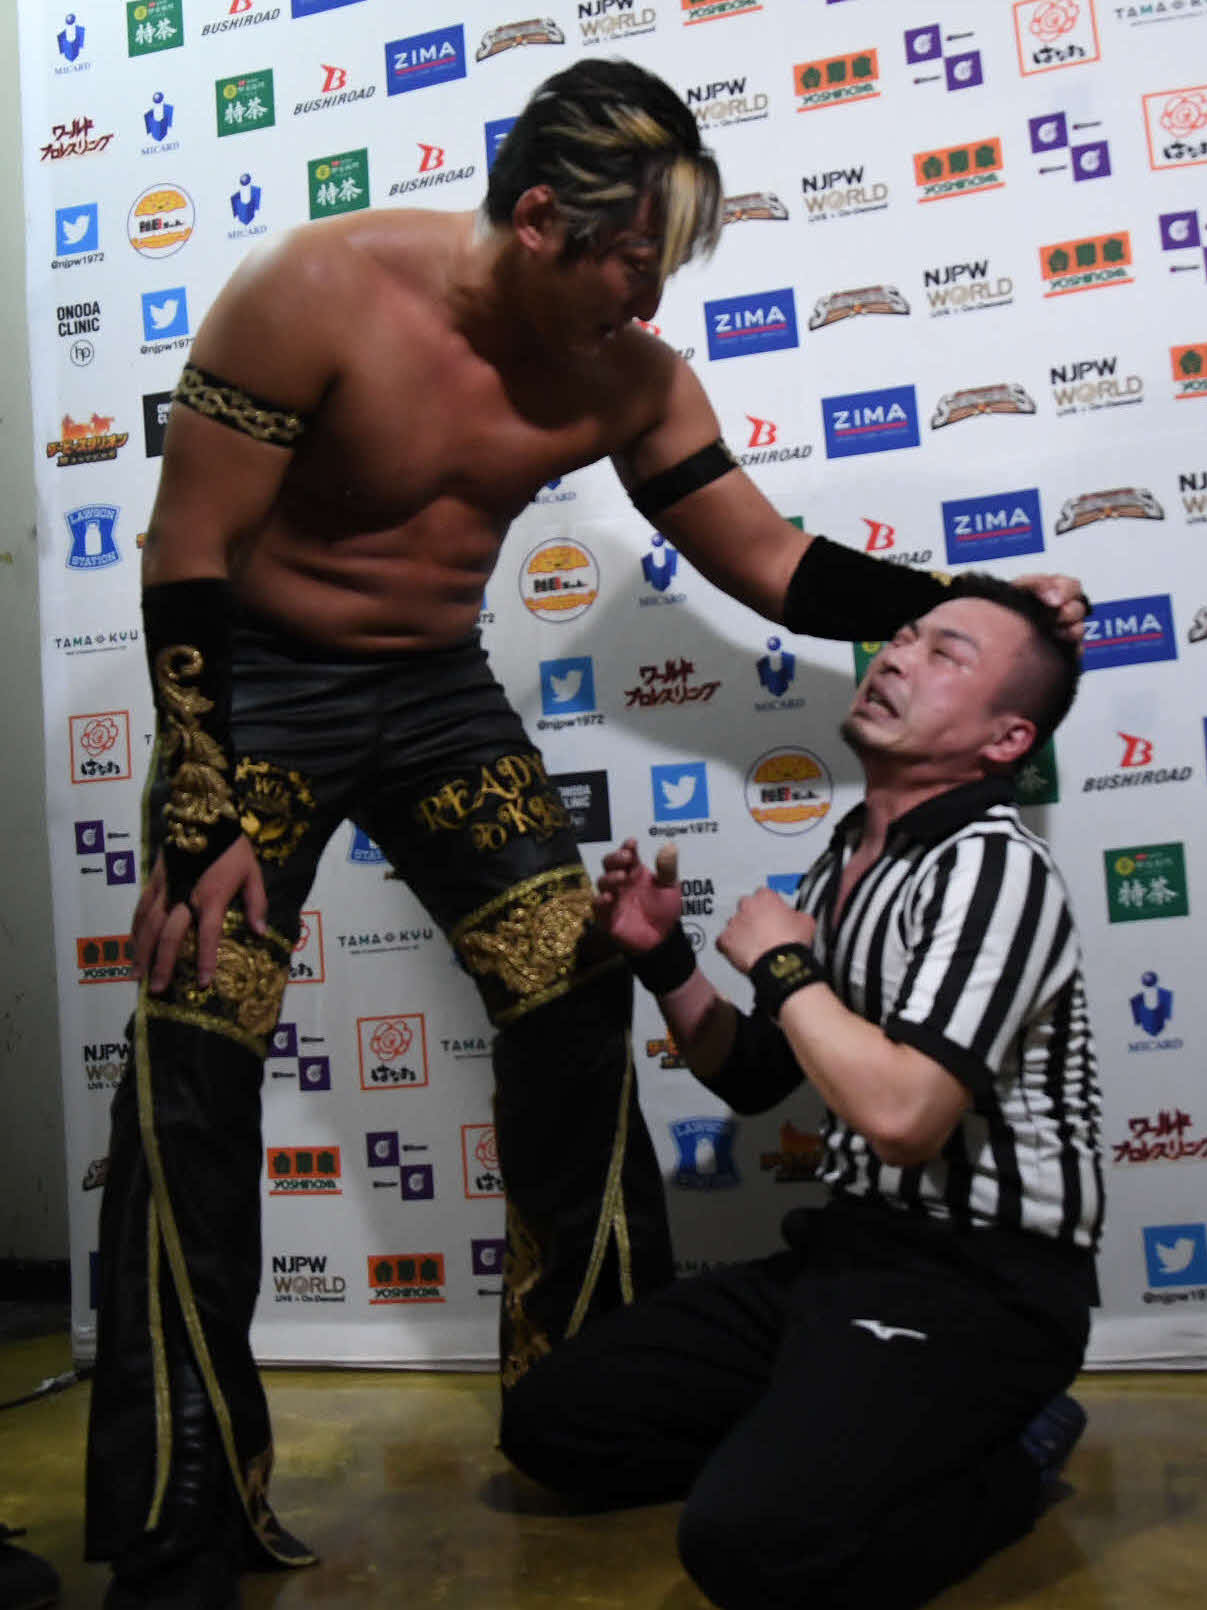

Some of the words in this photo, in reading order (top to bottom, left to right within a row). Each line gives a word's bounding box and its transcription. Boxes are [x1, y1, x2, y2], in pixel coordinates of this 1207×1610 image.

[201, 8, 280, 36] BUSHIROAD
[578, 0, 633, 18] NJPW
[134, 17, 178, 45] 特茶
[394, 41, 456, 70] ZIMA
[293, 86, 376, 115] BUSHIROAD
[687, 77, 747, 104] NJPW
[224, 96, 268, 124] 特茶
[317, 177, 363, 206] 特茶
[389, 166, 475, 196] BUSHIROAD
[802, 166, 864, 193] NJPW
[51, 252, 105, 270] @njpw1972
[924, 259, 989, 287] NJPW
[57, 301, 101, 321] ONODA
[714, 305, 787, 333] ZIMA
[58, 318, 101, 337] CLINIC
[1050, 356, 1117, 385] NJPW
[832, 403, 907, 431] ZIMA
[740, 445, 812, 466] SHIROAD
[954, 507, 1030, 537] ZIMA
[1083, 613, 1162, 641] ZIMA
[537, 714, 605, 731] @njpw1972
[1082, 766, 1192, 793] BUSHIROAD
[648, 821, 720, 838] @njpw1972
[682, 879, 715, 896] ODA
[1117, 874, 1179, 908] 特茶
[272, 1256, 327, 1274] NJPW
